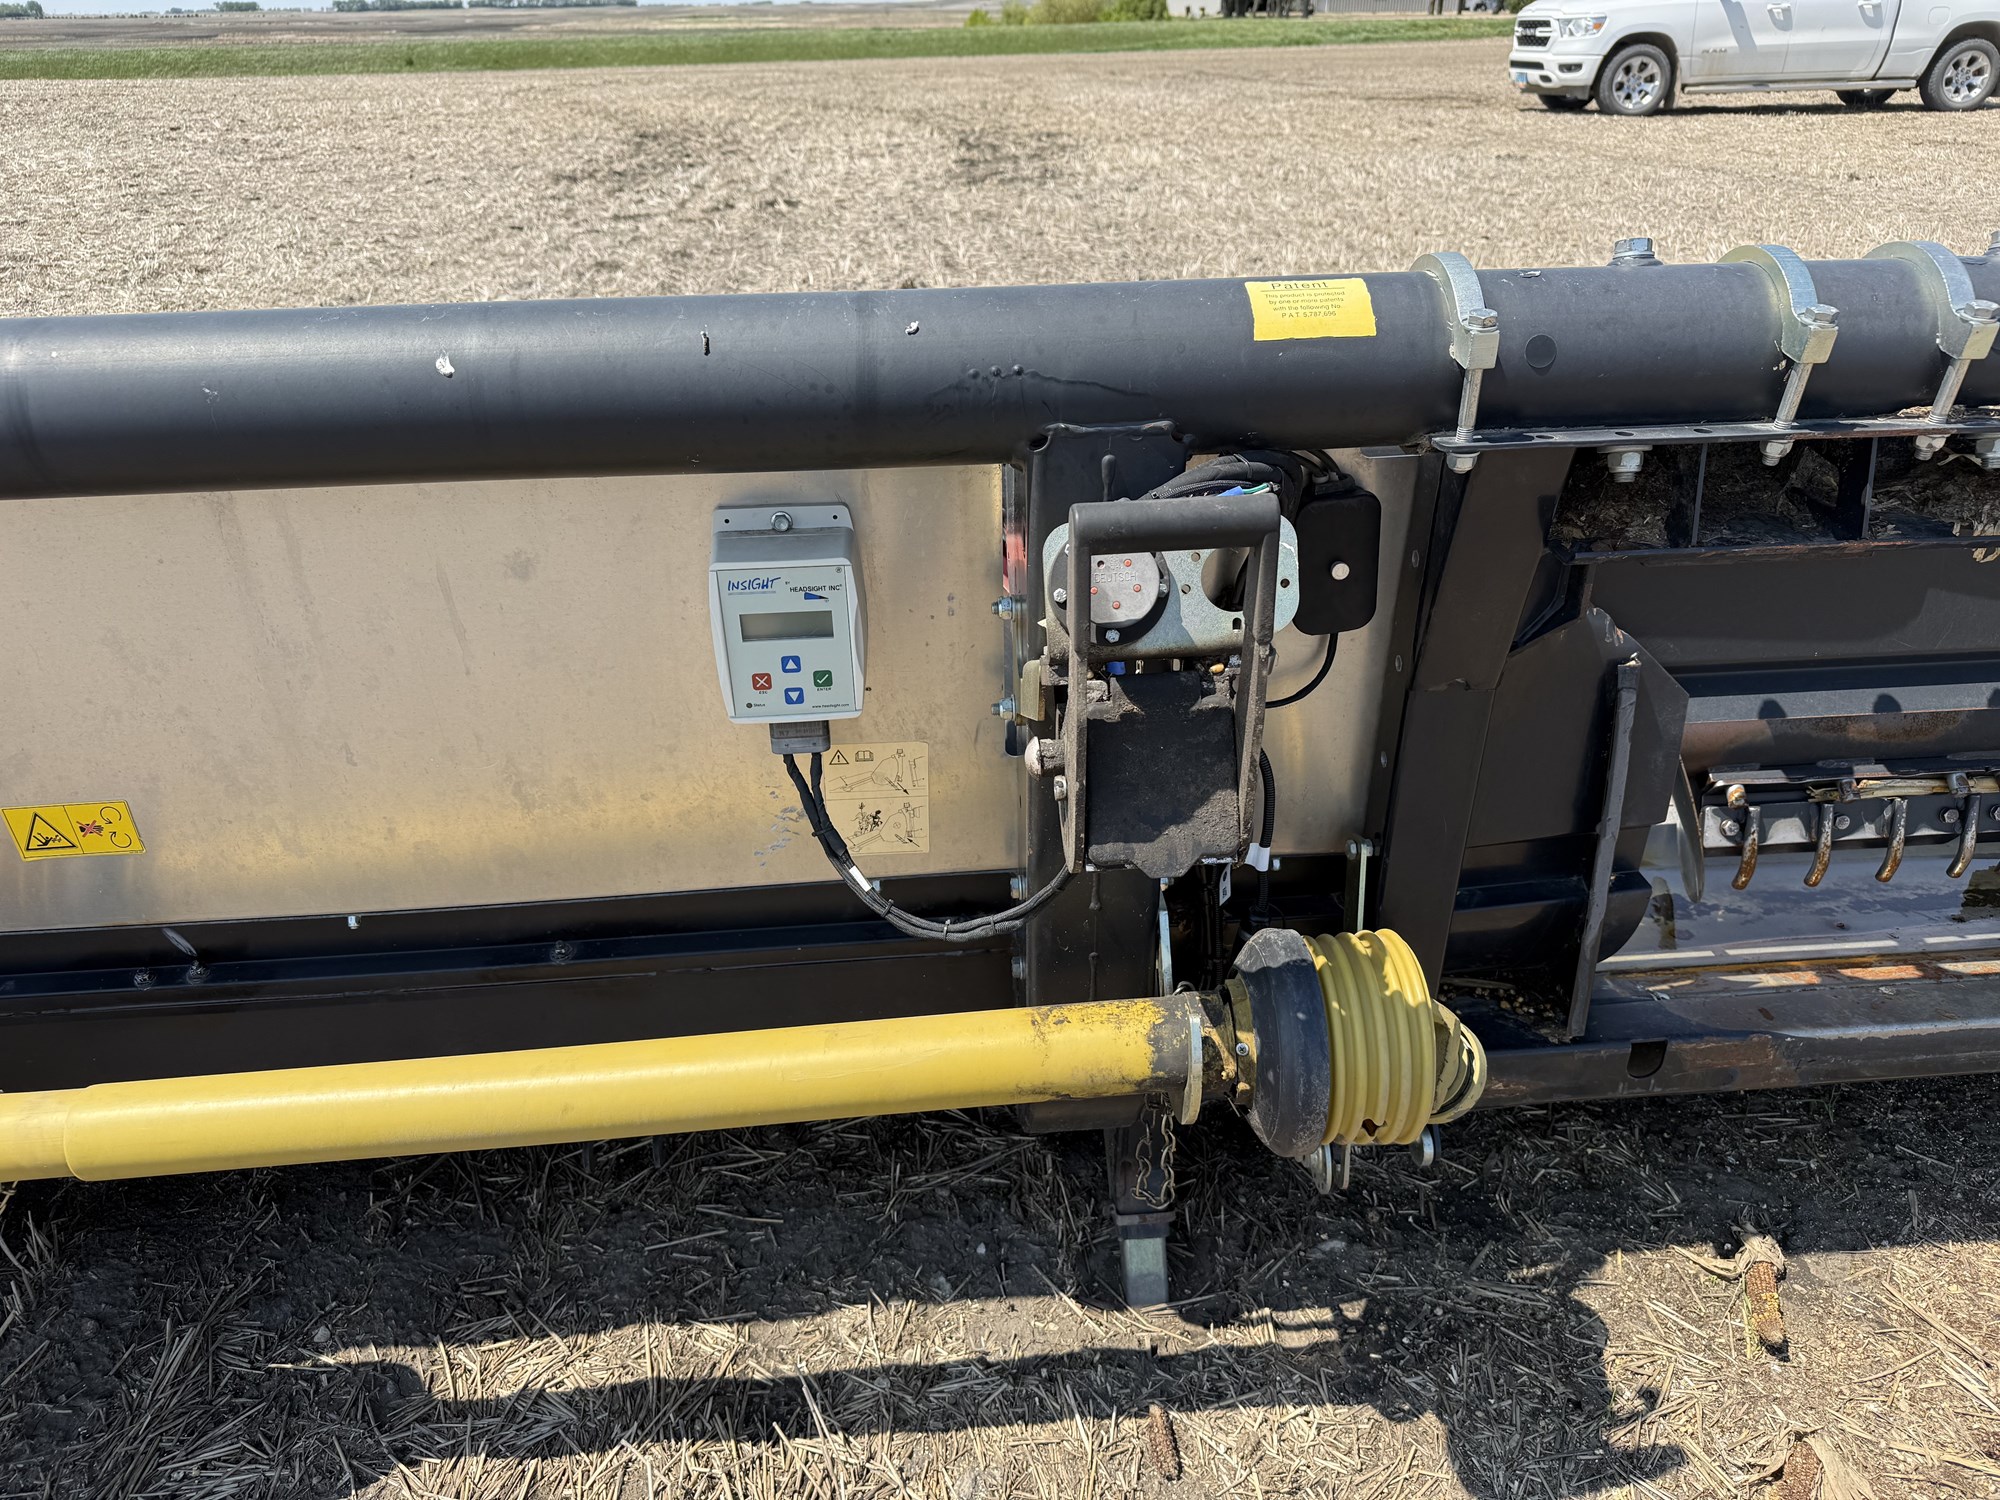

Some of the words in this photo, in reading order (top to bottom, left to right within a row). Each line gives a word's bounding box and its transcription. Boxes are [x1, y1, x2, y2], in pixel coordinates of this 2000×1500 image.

[1271, 281, 1328, 290] Patent
[1094, 572, 1137, 583] DEUTSCH
[727, 576, 781, 591] INSIGHT
